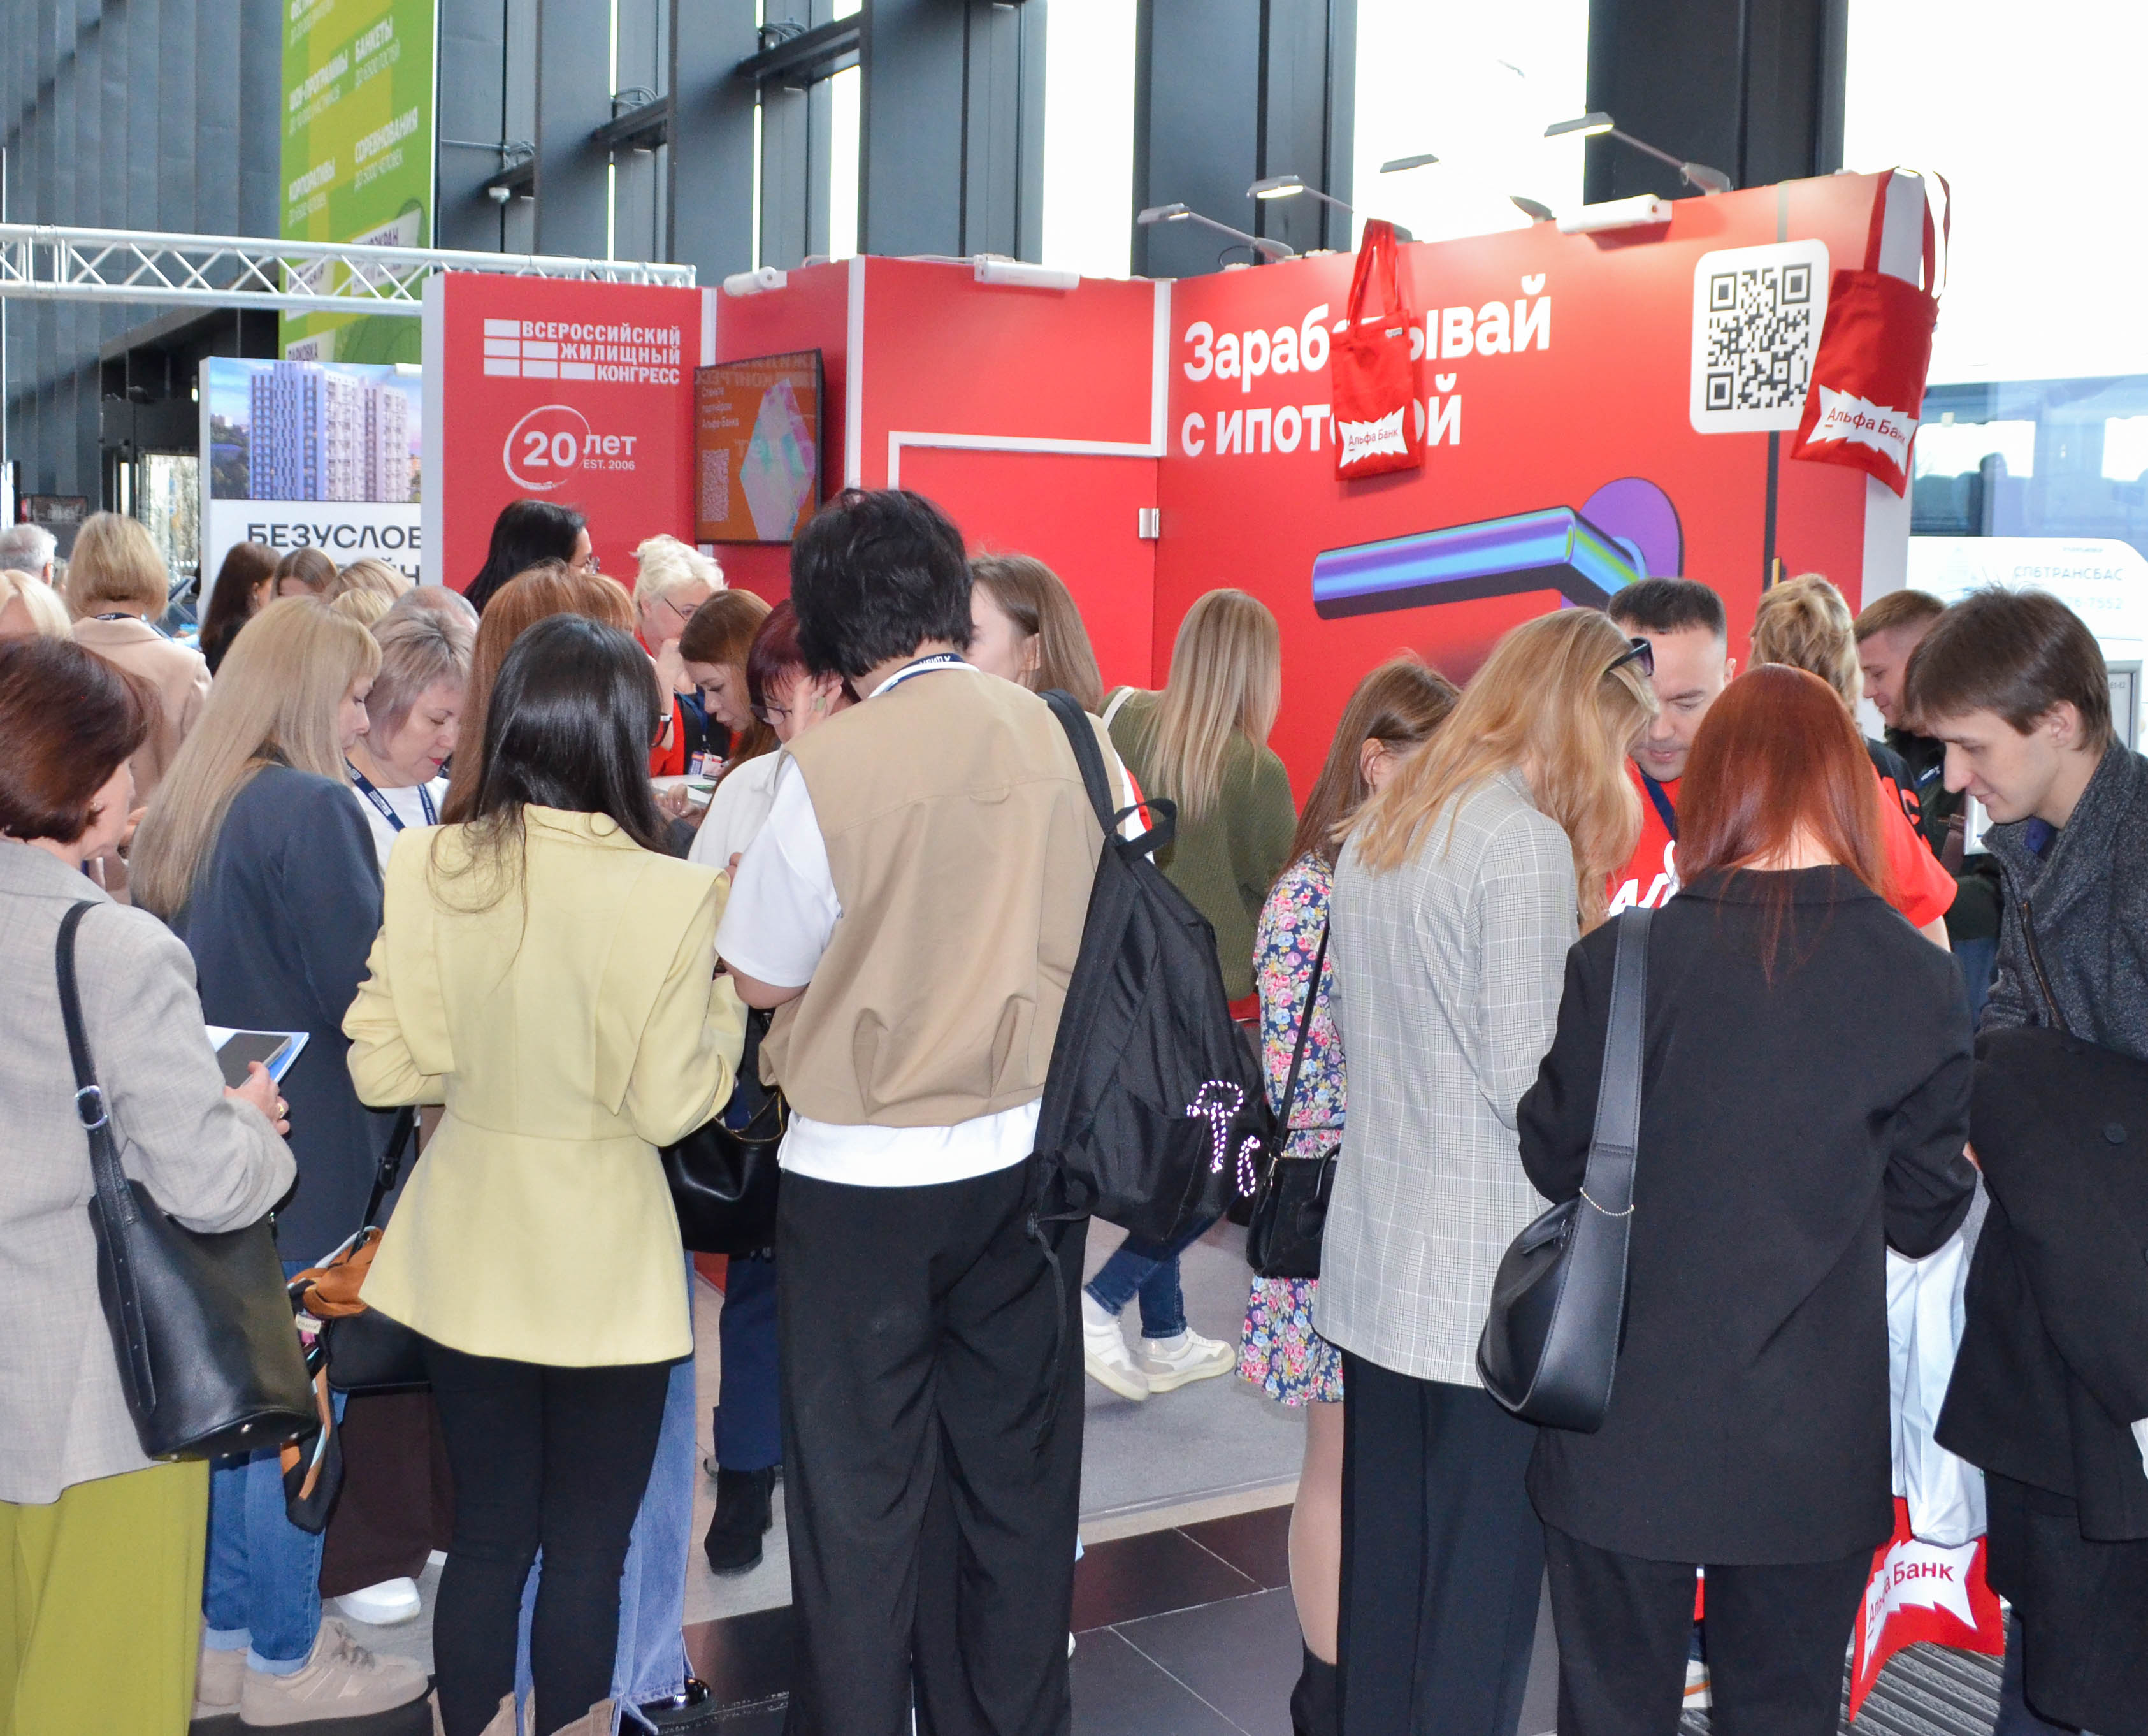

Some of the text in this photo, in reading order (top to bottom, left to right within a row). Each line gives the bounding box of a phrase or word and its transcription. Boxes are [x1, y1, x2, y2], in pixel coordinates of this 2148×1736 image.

[522, 321, 680, 345] ВСЕРОССИЙСКИЙ
[1184, 273, 1551, 393] Зарабывай
[561, 342, 680, 365] ЖИЛИЩНЫЙ
[597, 365, 680, 384] КОНГРЕСС
[1181, 372, 1462, 457] с ипотй
[1827, 407, 1876, 430] Альфа
[523, 431, 637, 467] 20 лет
[1349, 428, 1398, 447] Альфа Банк
[583, 459, 635, 470] EST. 2006
[2014, 565, 2123, 581] СПБТРАНСБАС
[1894, 1560, 1954, 1587] Банк
